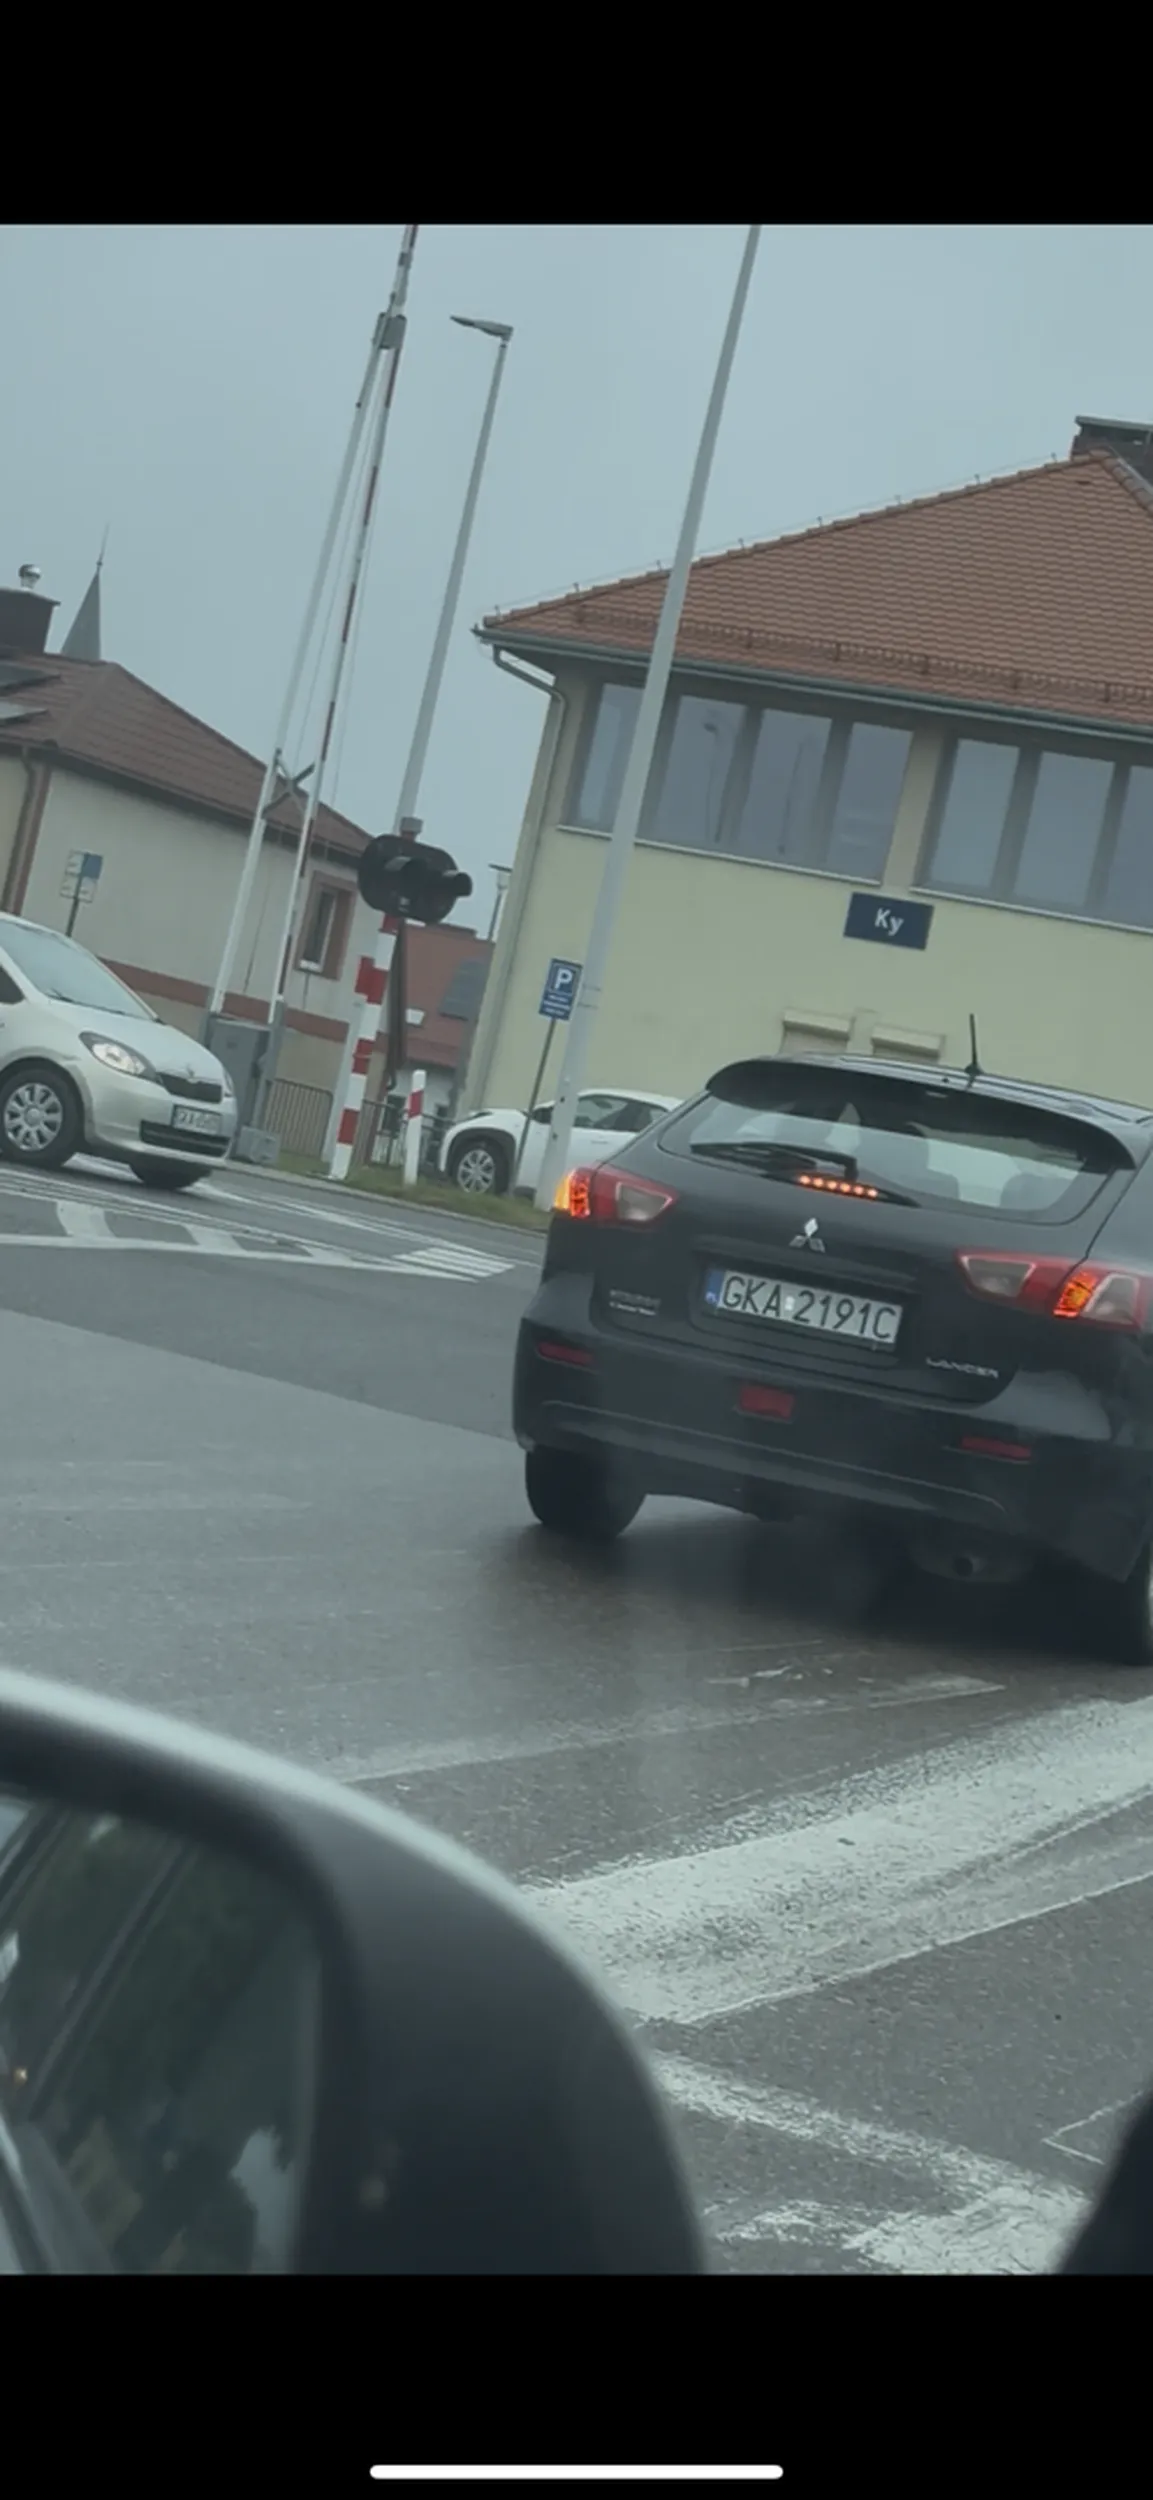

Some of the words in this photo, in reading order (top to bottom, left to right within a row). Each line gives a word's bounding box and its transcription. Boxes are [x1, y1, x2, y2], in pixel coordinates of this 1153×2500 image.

[875, 907, 904, 936] Ky
[555, 967, 573, 989] P
[722, 1275, 781, 1317] GKA
[792, 1290, 896, 1340] 2191C
